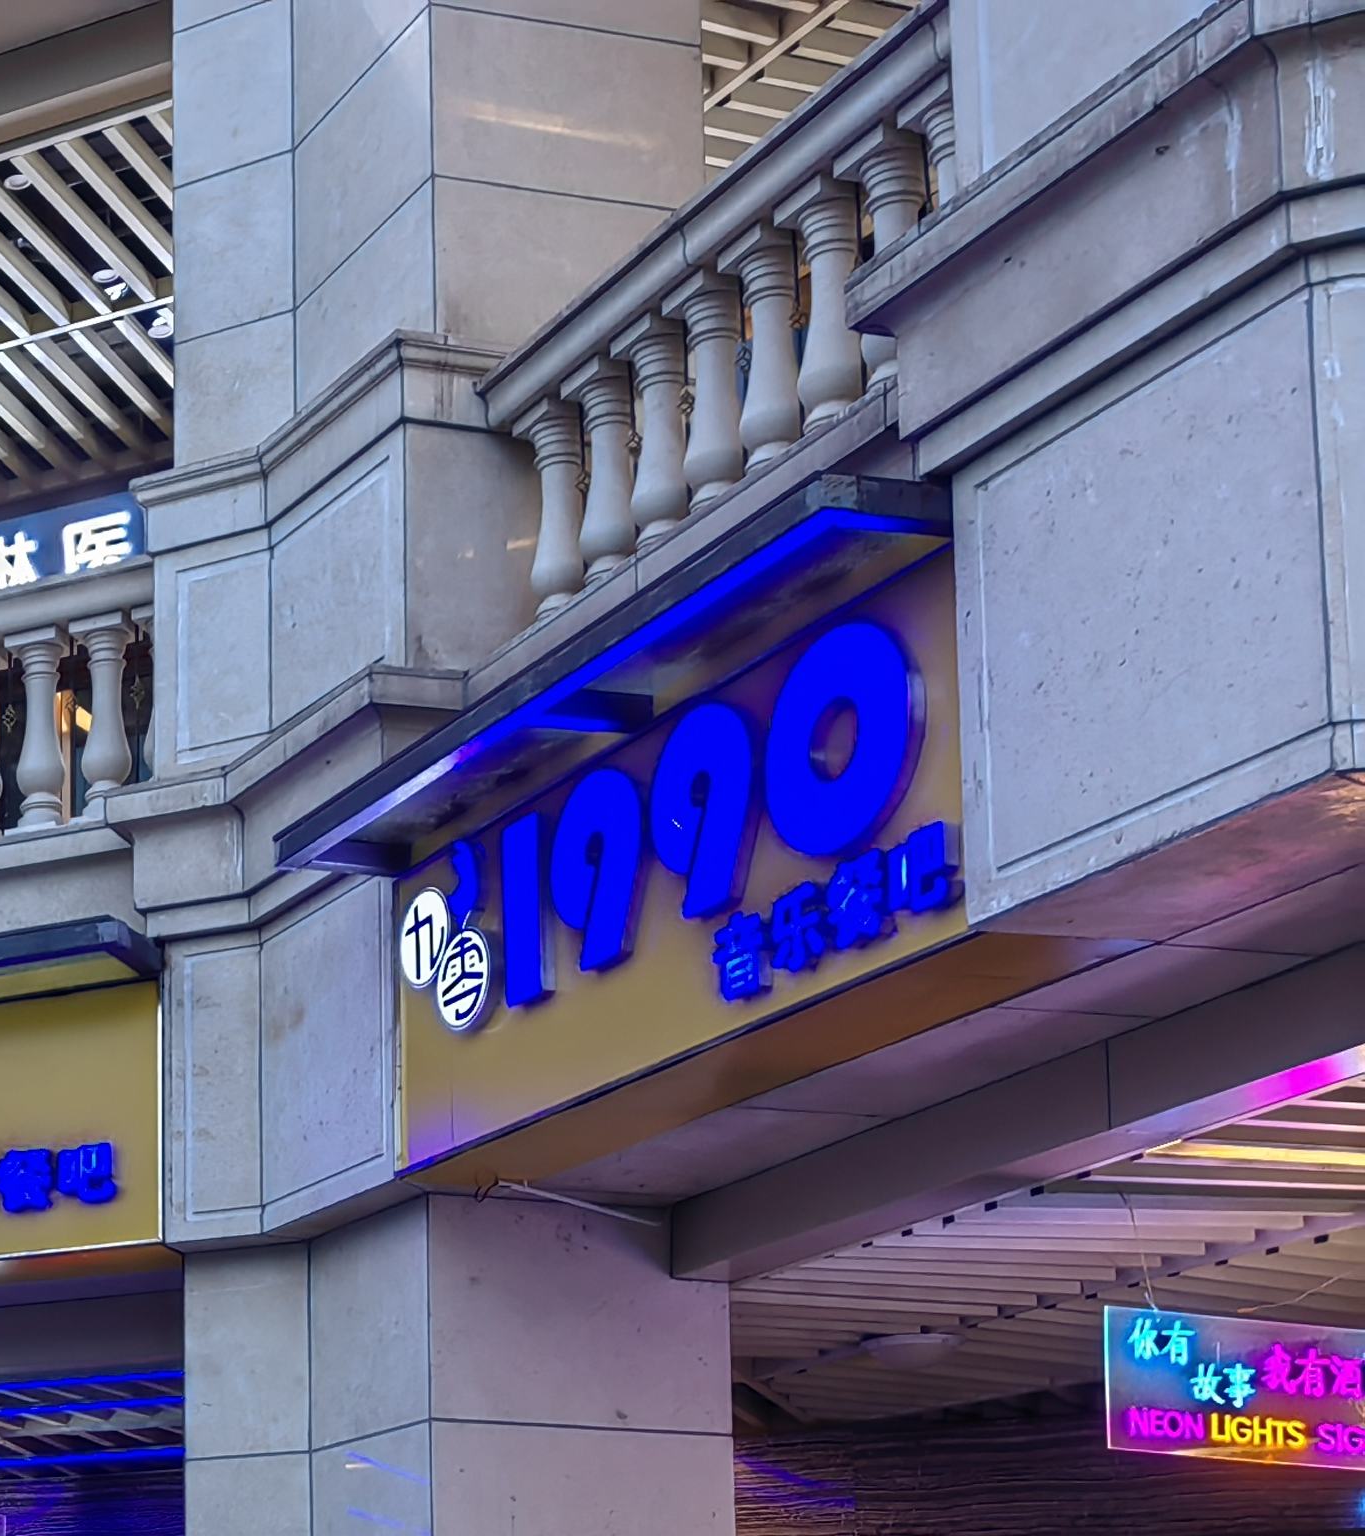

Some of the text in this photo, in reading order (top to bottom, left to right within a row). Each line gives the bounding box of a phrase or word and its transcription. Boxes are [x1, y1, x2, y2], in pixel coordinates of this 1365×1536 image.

[499, 618, 926, 1008] 1990
[712, 820, 961, 1002] 音乐餐吧
[1127, 1317, 1197, 1366] 你有
[1189, 1363, 1257, 1409] 故事
[1261, 1344, 1364, 1398] 我有酒
[1129, 1406, 1365, 1455] NEON LIGHTS SIG
